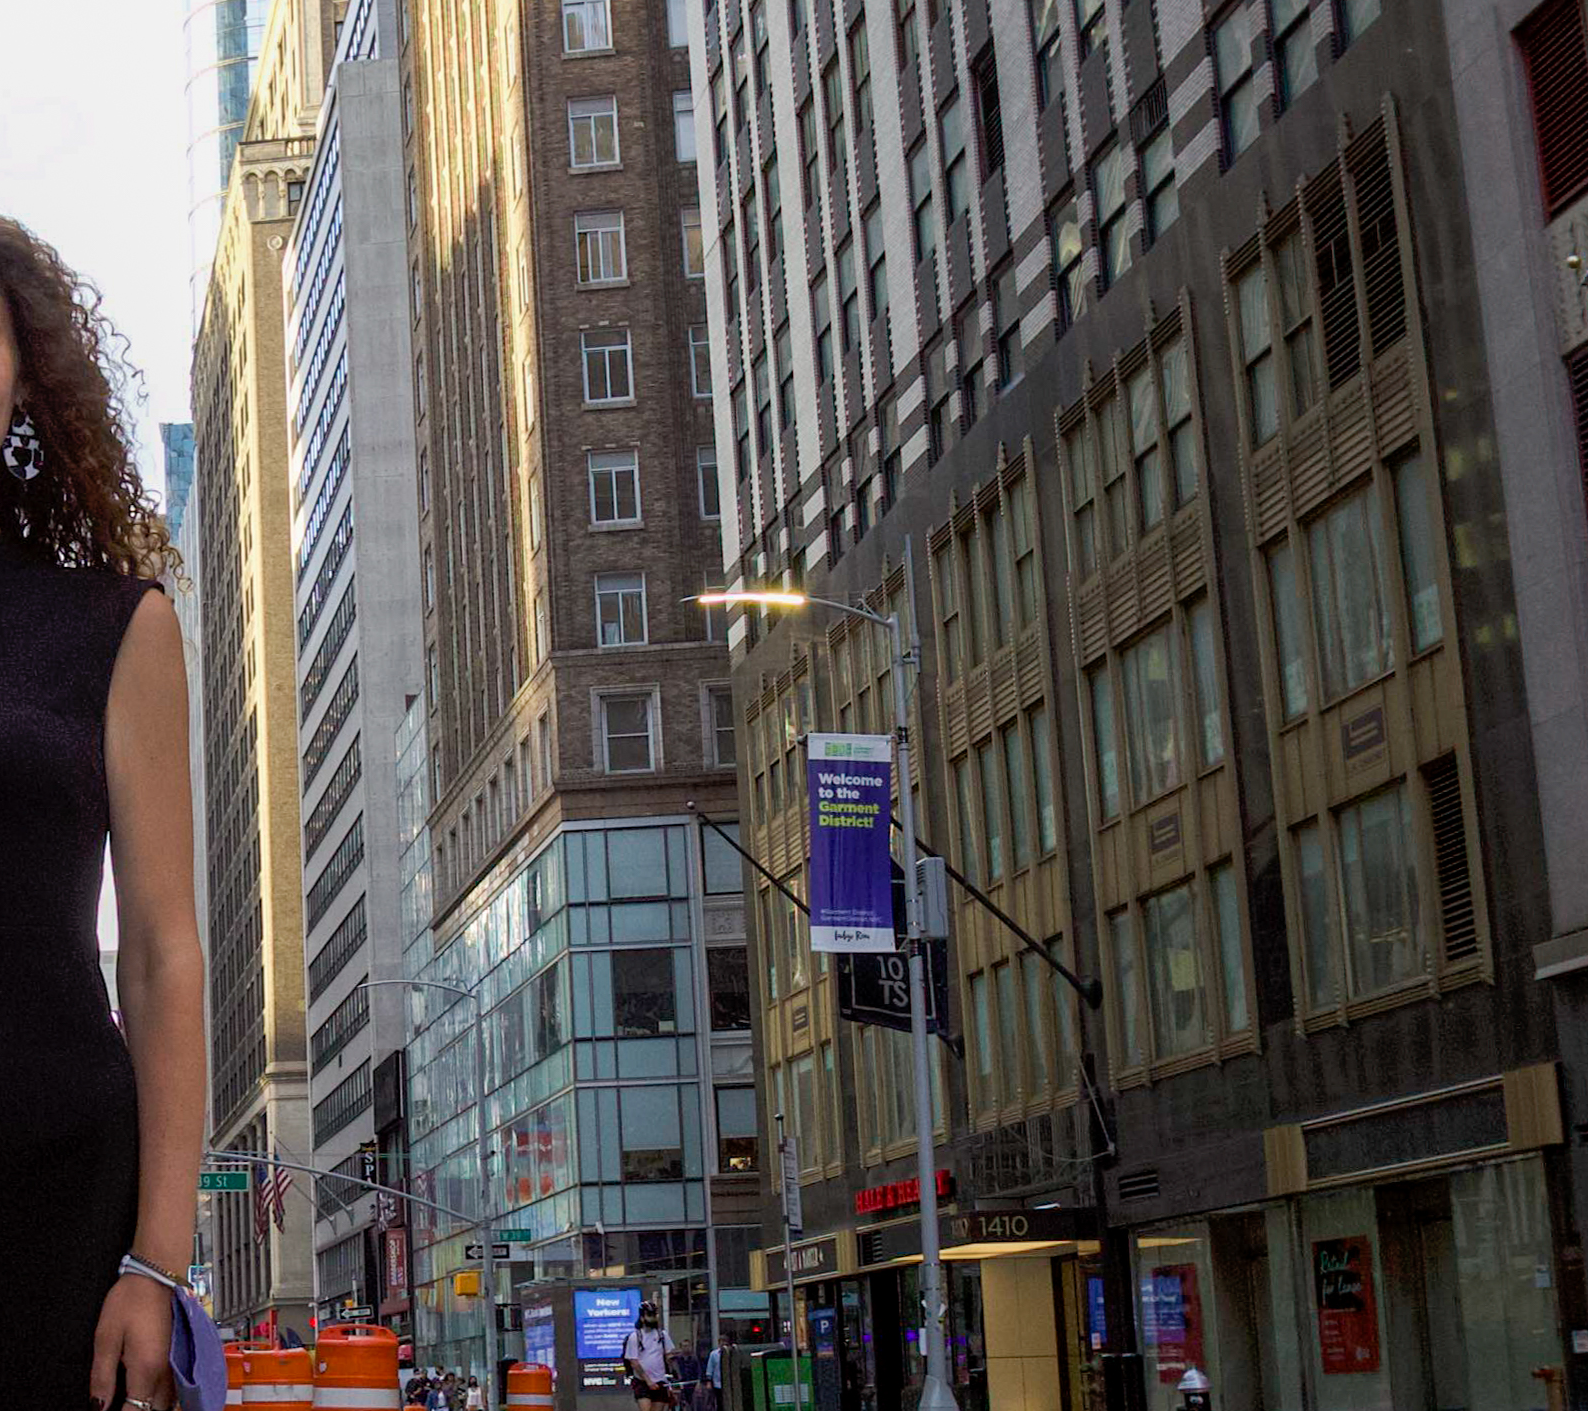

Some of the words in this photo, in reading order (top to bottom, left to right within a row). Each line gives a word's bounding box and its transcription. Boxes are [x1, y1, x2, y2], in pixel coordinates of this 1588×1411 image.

[818, 772, 883, 787] Welcome
[819, 788, 834, 799] to
[836, 787, 860, 799] the
[819, 802, 880, 814] Garment
[819, 814, 874, 828] District!
[216, 1176, 228, 1187] St
[979, 1215, 1028, 1237] 1410
[595, 1298, 620, 1306] New
[820, 1319, 829, 1334] P
